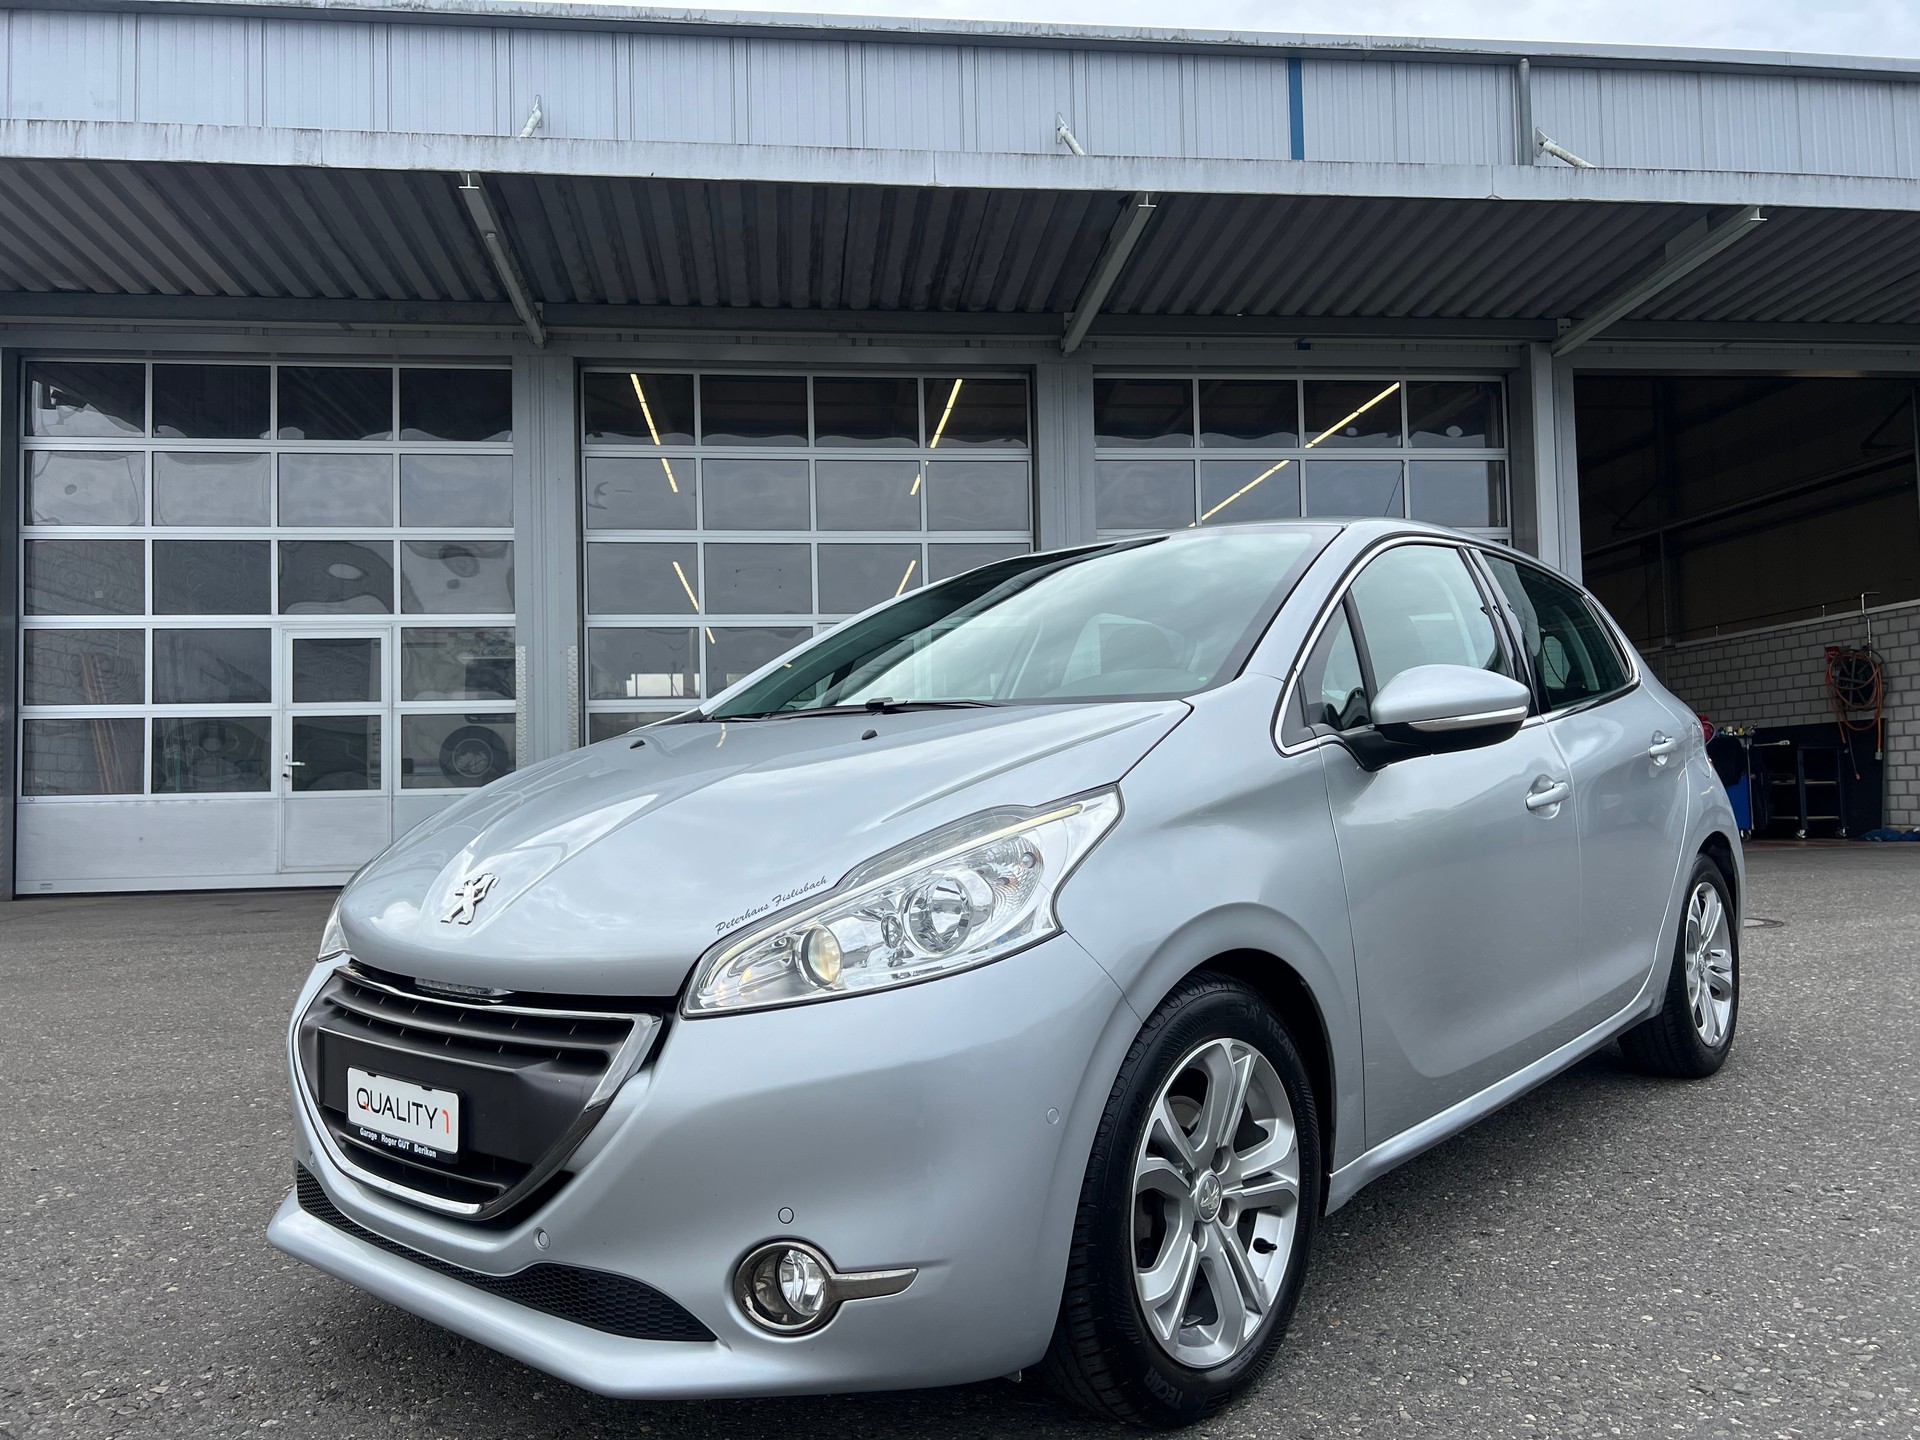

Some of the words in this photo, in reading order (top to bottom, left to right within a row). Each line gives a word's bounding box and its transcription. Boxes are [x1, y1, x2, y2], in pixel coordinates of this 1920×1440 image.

[715, 904, 769, 935] Peterhans
[772, 876, 827, 907] Fislisbach
[356, 1087, 438, 1129] QUALITY
[359, 1127, 378, 1141] Garage
[381, 1134, 397, 1147] Roger
[397, 1139, 410, 1150] GUT
[413, 1143, 437, 1158] Berikon
